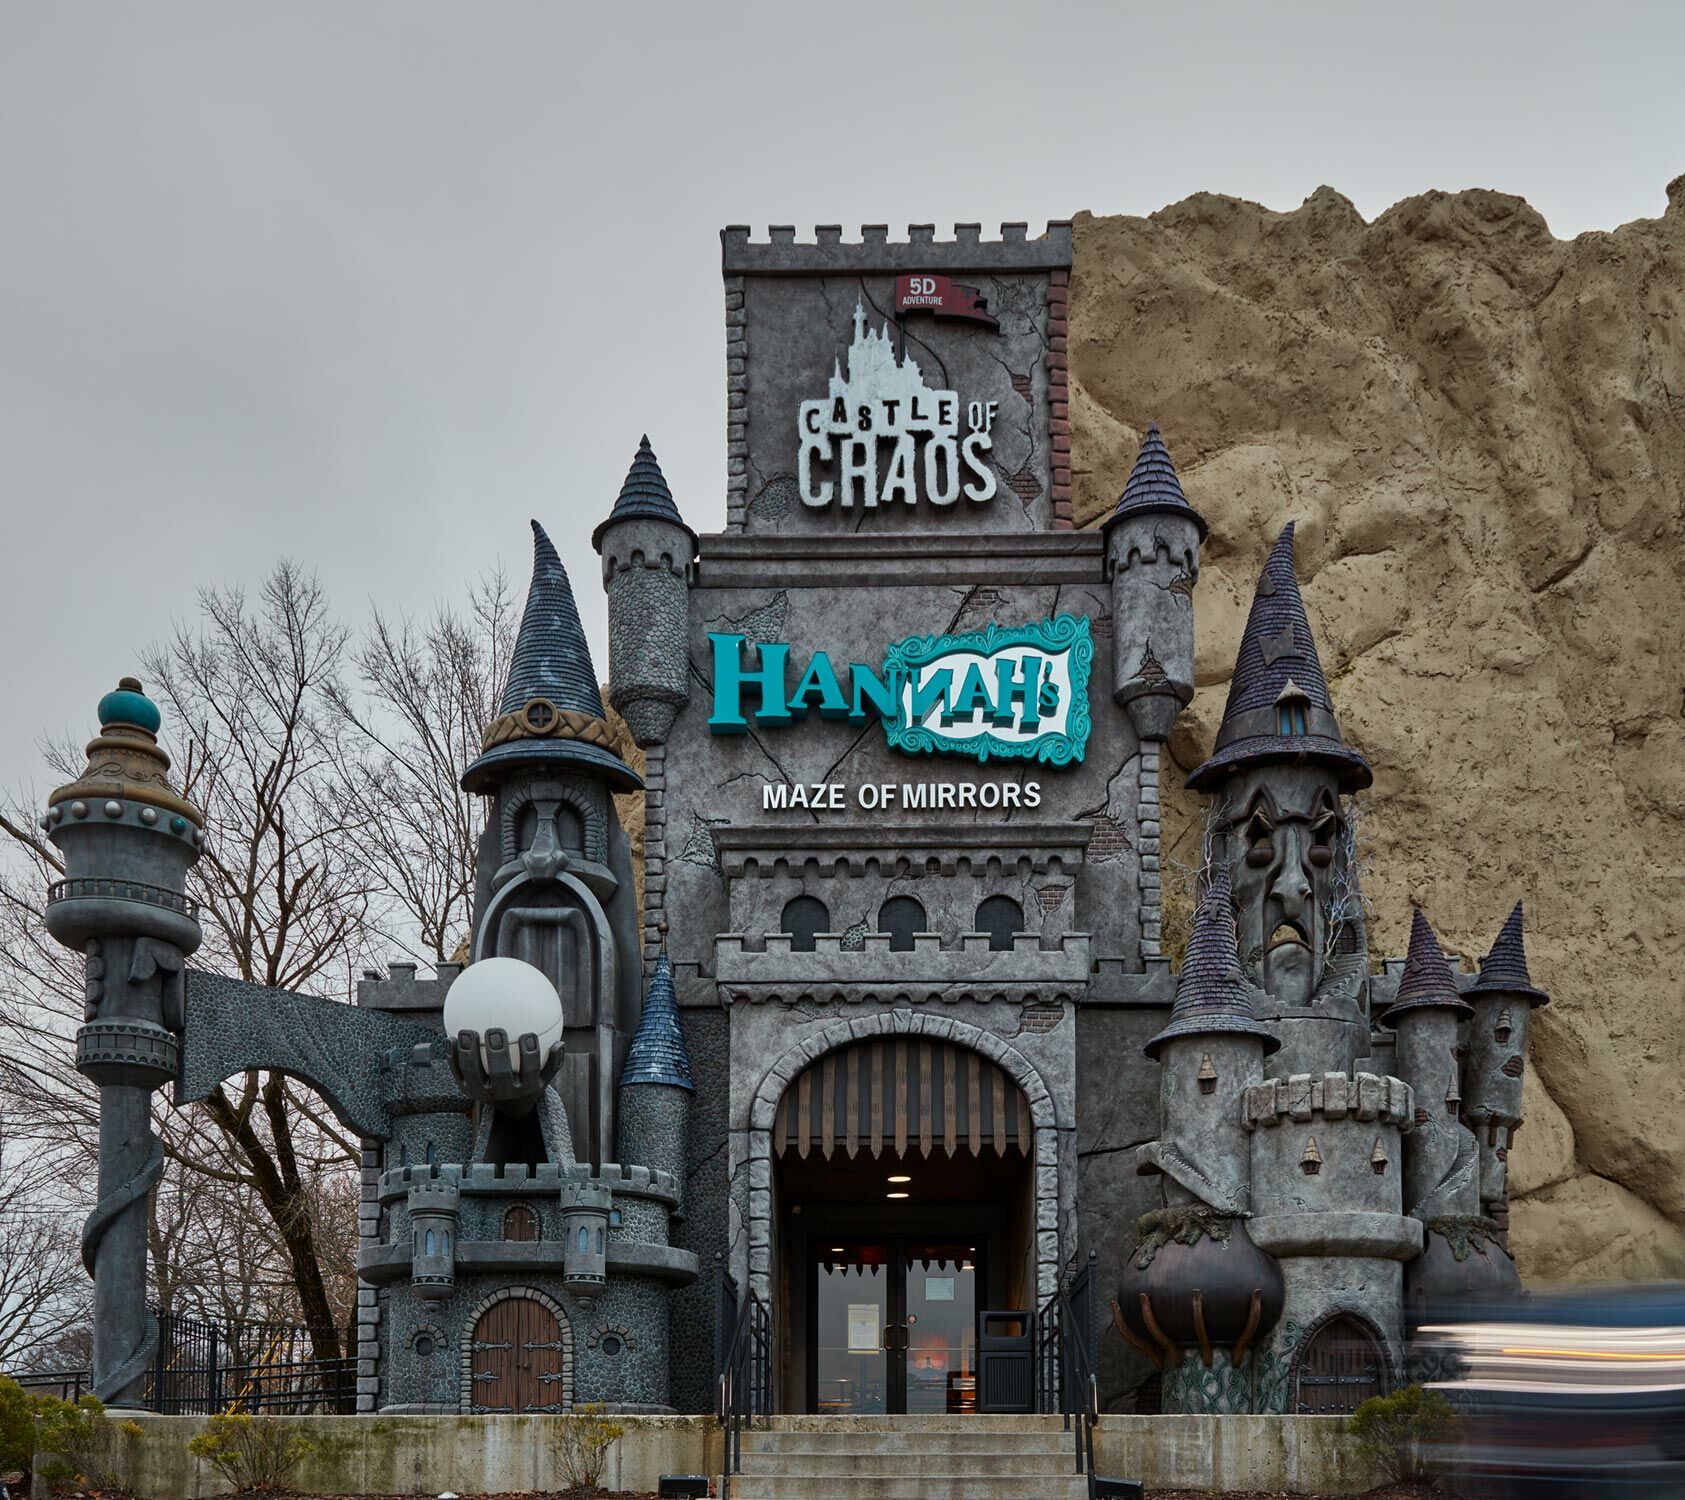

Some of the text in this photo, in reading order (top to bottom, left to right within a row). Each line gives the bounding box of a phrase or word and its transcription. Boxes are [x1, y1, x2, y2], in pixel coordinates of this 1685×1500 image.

[910, 278, 936, 294] 5D
[902, 296, 942, 305] ADVENTURE
[806, 396, 998, 433] CASTLE OF
[799, 432, 997, 507] CHAOS
[763, 782, 1041, 809] MAZE OF MIRRORS
